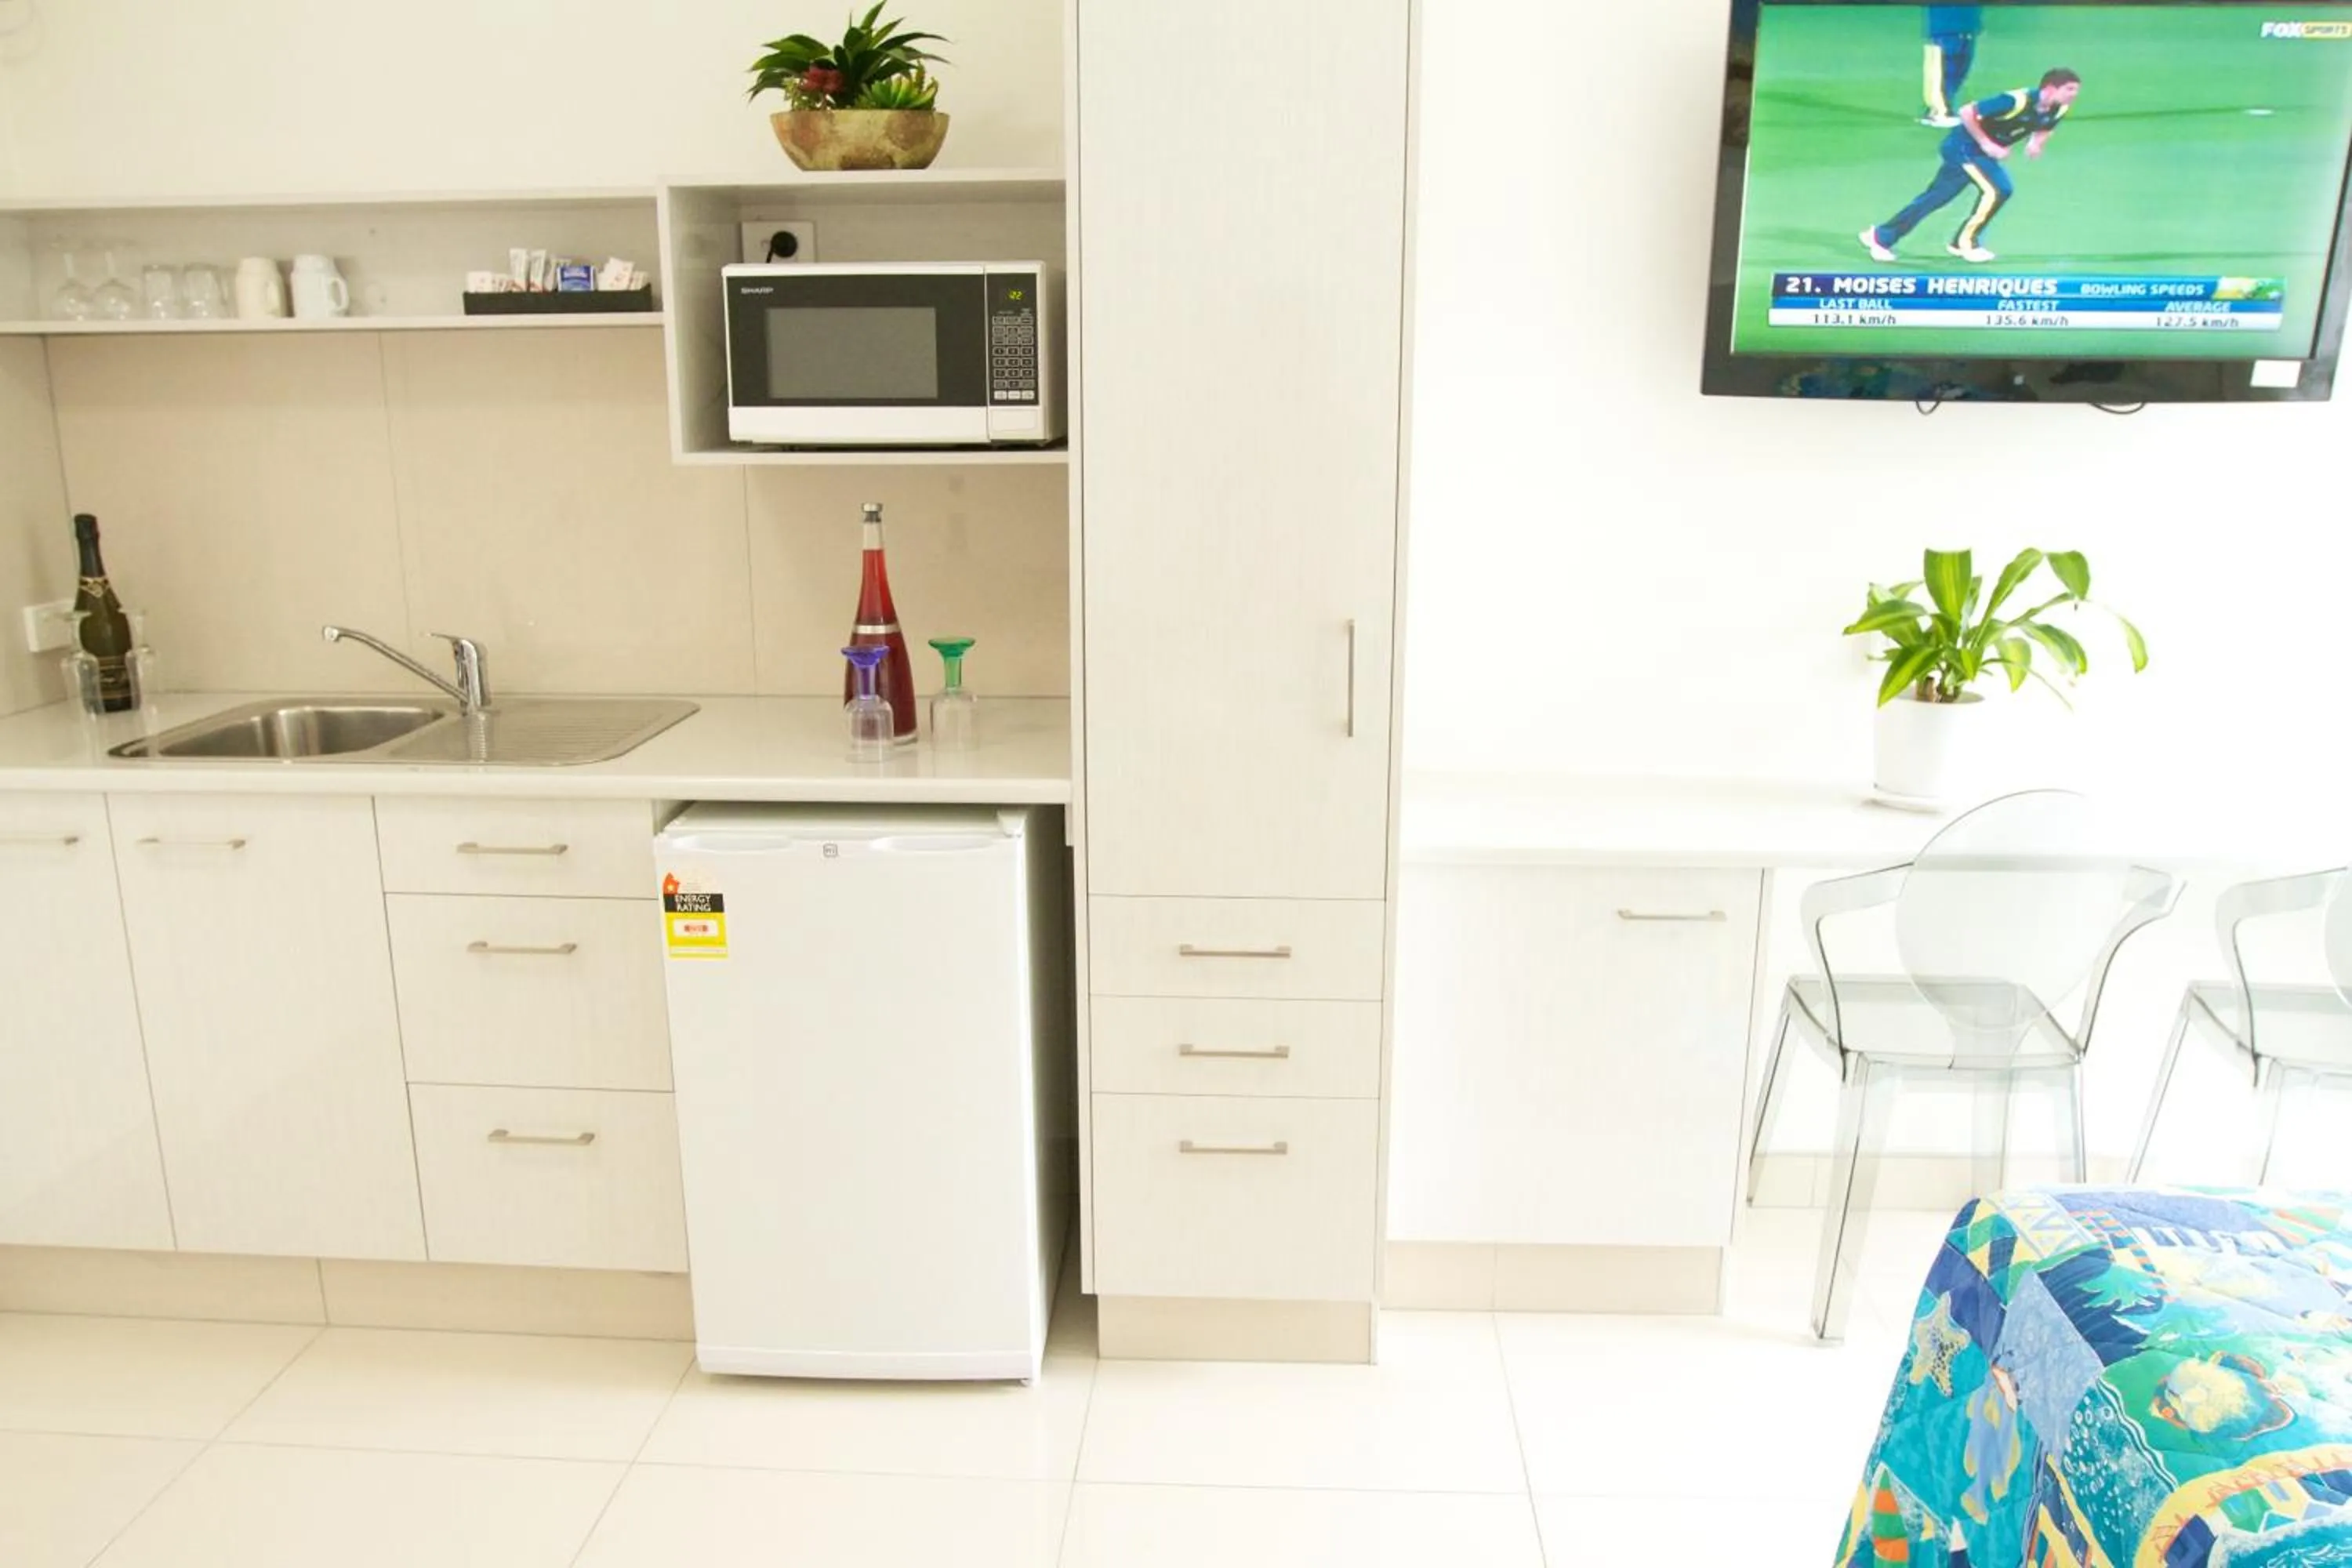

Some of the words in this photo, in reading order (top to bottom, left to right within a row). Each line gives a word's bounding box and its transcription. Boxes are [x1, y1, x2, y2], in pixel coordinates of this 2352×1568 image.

[2260, 22, 2302, 38] FOX
[1785, 277, 1821, 293] 21.
[1833, 277, 1916, 294] MOISES
[1927, 277, 2058, 297] HENRIQUES
[2080, 283, 2146, 296] BOWLING
[2150, 284, 2205, 296] SPEEDS
[1819, 298, 1856, 309] LAST
[1858, 299, 1893, 310] BALL
[1997, 299, 2060, 311] FASTEST
[2165, 301, 2232, 313] AVERAGE
[1813, 314, 1853, 325] 113.1
[1858, 314, 1896, 325] km/h
[1986, 314, 2027, 326] 135.6
[2031, 315, 2070, 326] km/h
[2157, 316, 2197, 328] 127.5
[2201, 317, 2240, 328] km/h
[675, 894, 712, 903] ENERGY
[677, 903, 712, 912] RATING
